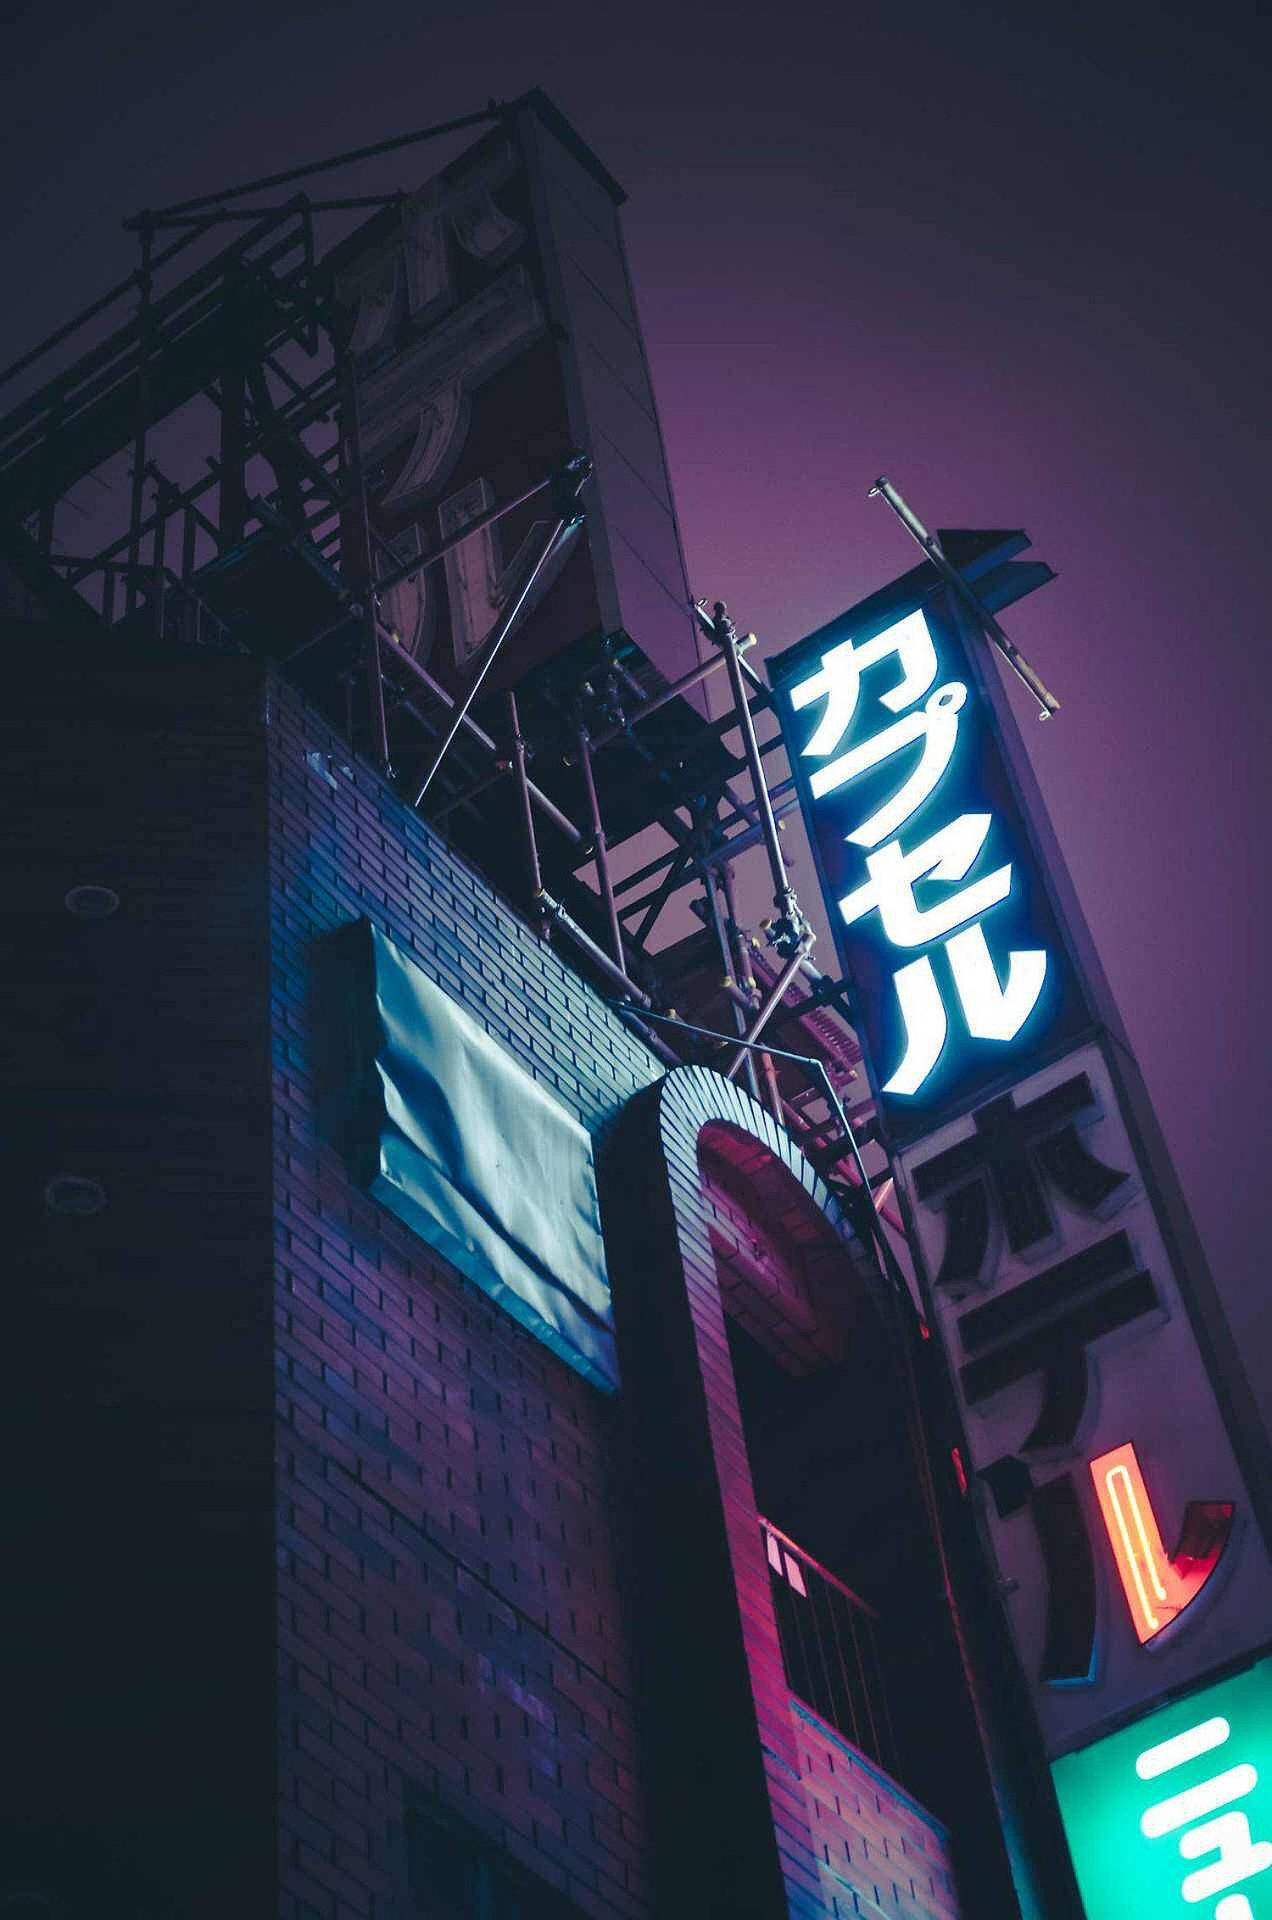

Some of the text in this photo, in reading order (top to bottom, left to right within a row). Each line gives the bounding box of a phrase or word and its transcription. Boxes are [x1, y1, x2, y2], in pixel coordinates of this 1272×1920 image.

[337, 132, 586, 668] ホテル
[790, 608, 1046, 1096] カプセル
[911, 1072, 1235, 1685] ホテル
[1136, 1716, 1272, 1920] ニュ
